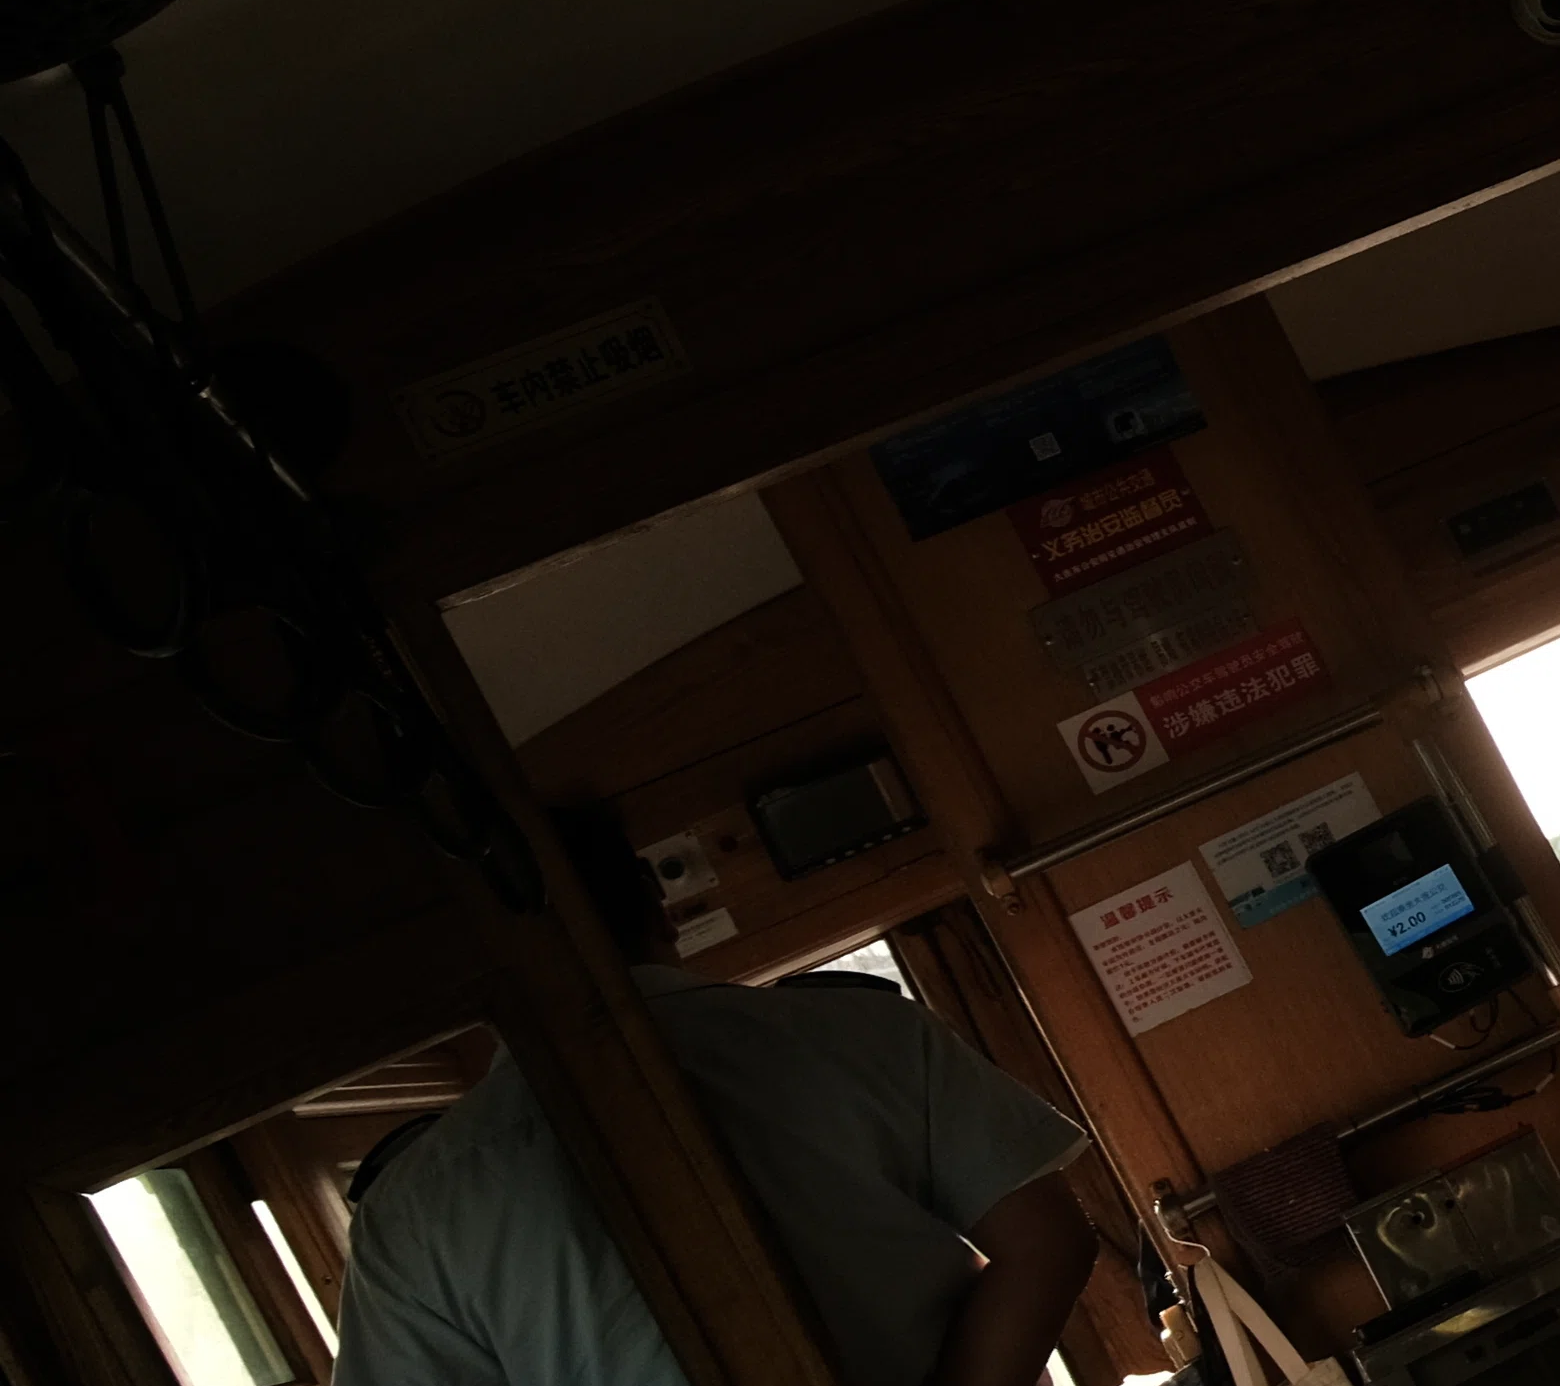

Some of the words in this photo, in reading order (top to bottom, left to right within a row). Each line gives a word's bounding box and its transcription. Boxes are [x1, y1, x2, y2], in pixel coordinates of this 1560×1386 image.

[488, 325, 665, 414] 车内禁止吸烟
[1039, 487, 1184, 562] 义务治安监督员
[1162, 652, 1320, 740] 涉嫌违法犯罪
[1099, 883, 1175, 931] 温馨提示
[1386, 909, 1427, 940] ¥2.00
